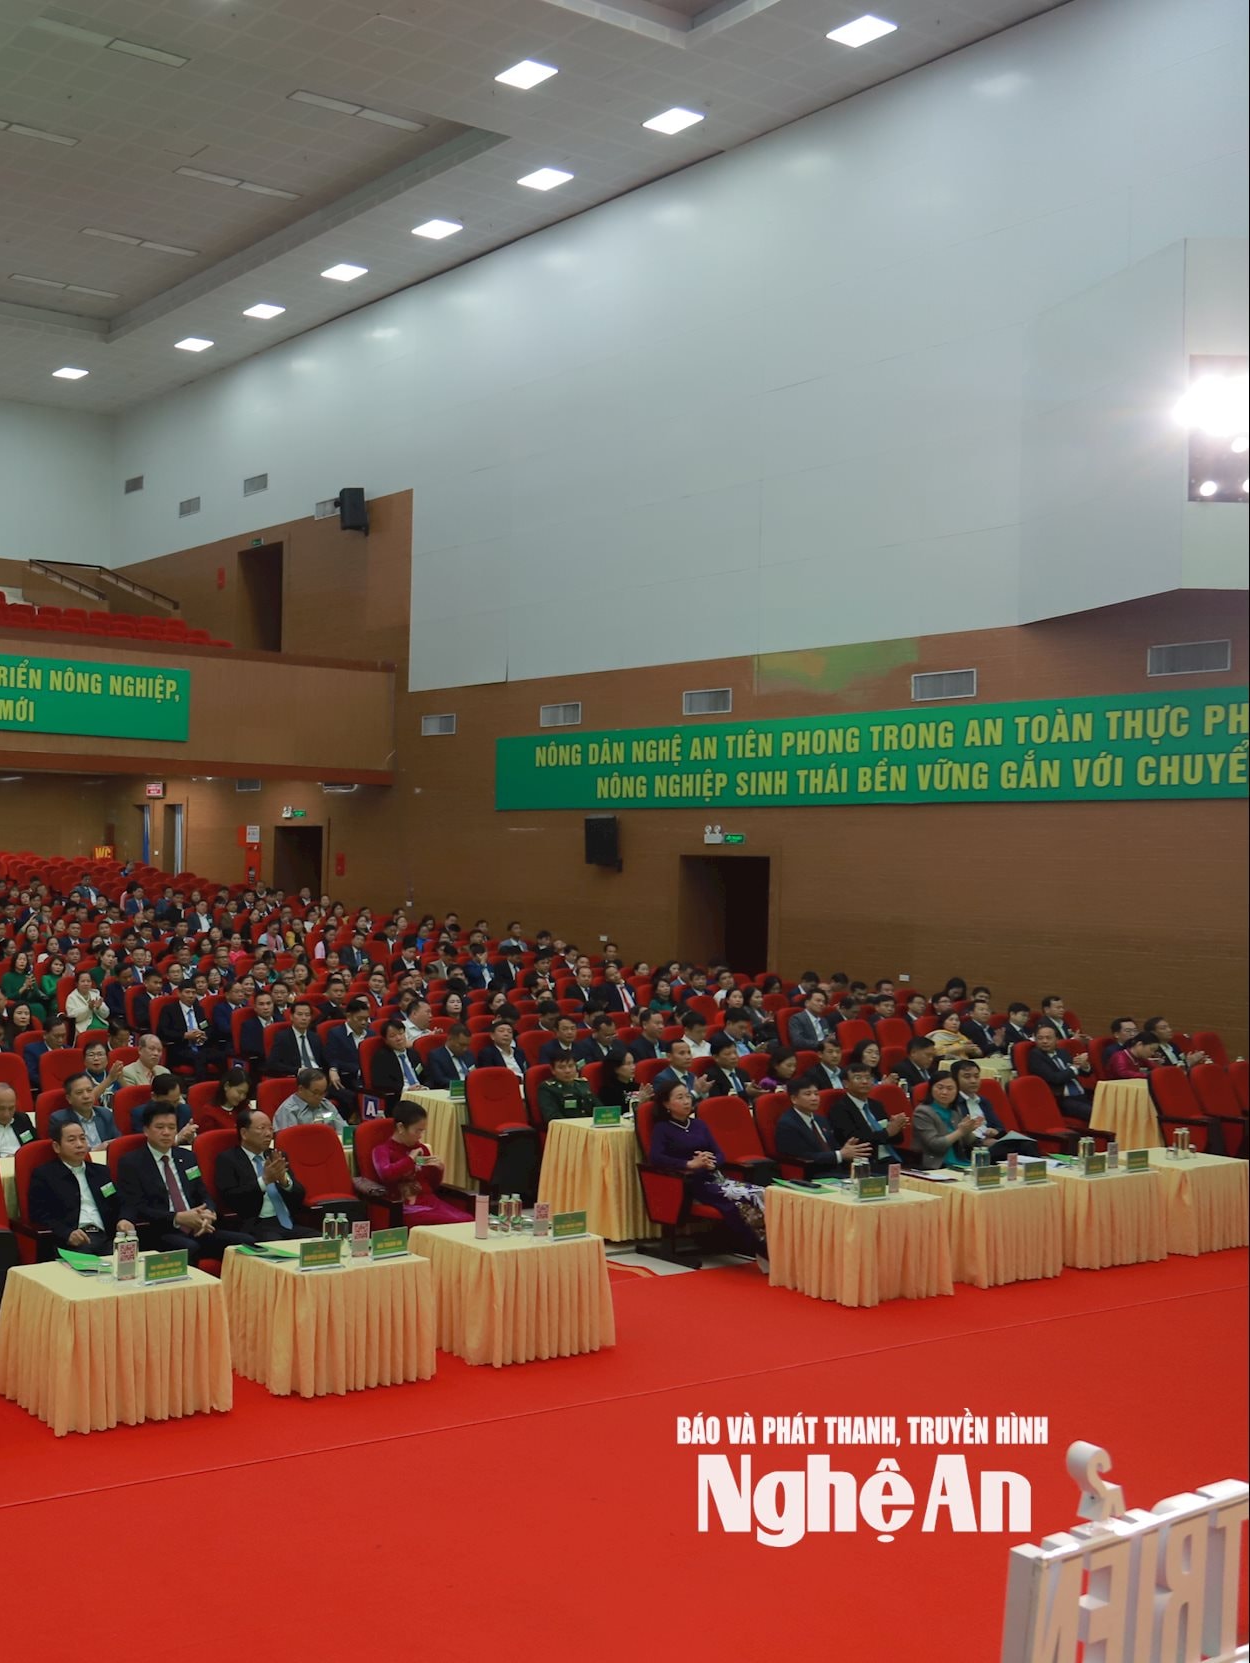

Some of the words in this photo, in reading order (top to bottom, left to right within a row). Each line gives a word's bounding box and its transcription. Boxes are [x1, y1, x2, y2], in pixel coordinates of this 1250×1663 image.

[50, 665, 102, 694] NÔNG
[109, 672, 181, 702] NGHIỆP,
[535, 740, 582, 768] NÔNG
[588, 737, 625, 766] DÂN
[632, 733, 682, 767] NGHỆ
[689, 735, 717, 761] AN
[725, 728, 772, 759] TIÊN
[781, 726, 860, 756] PHONG
[870, 719, 954, 752] TRONG
[964, 717, 1003, 748] AN
[1014, 708, 1093, 746] TOÀN
[1106, 704, 1189, 746] THỰC
[596, 768, 647, 800] NÔNG
[654, 768, 727, 802] NGHIỆP
[736, 769, 788, 797] SINH
[796, 762, 848, 795] THÁI
[857, 756, 907, 793] BỀN
[917, 757, 989, 792] VỮNG
[1000, 749, 1060, 790] GẮN
[1072, 751, 1123, 789] VỚI
[95, 847, 111, 859] WC
[365, 1100, 377, 1117] A
